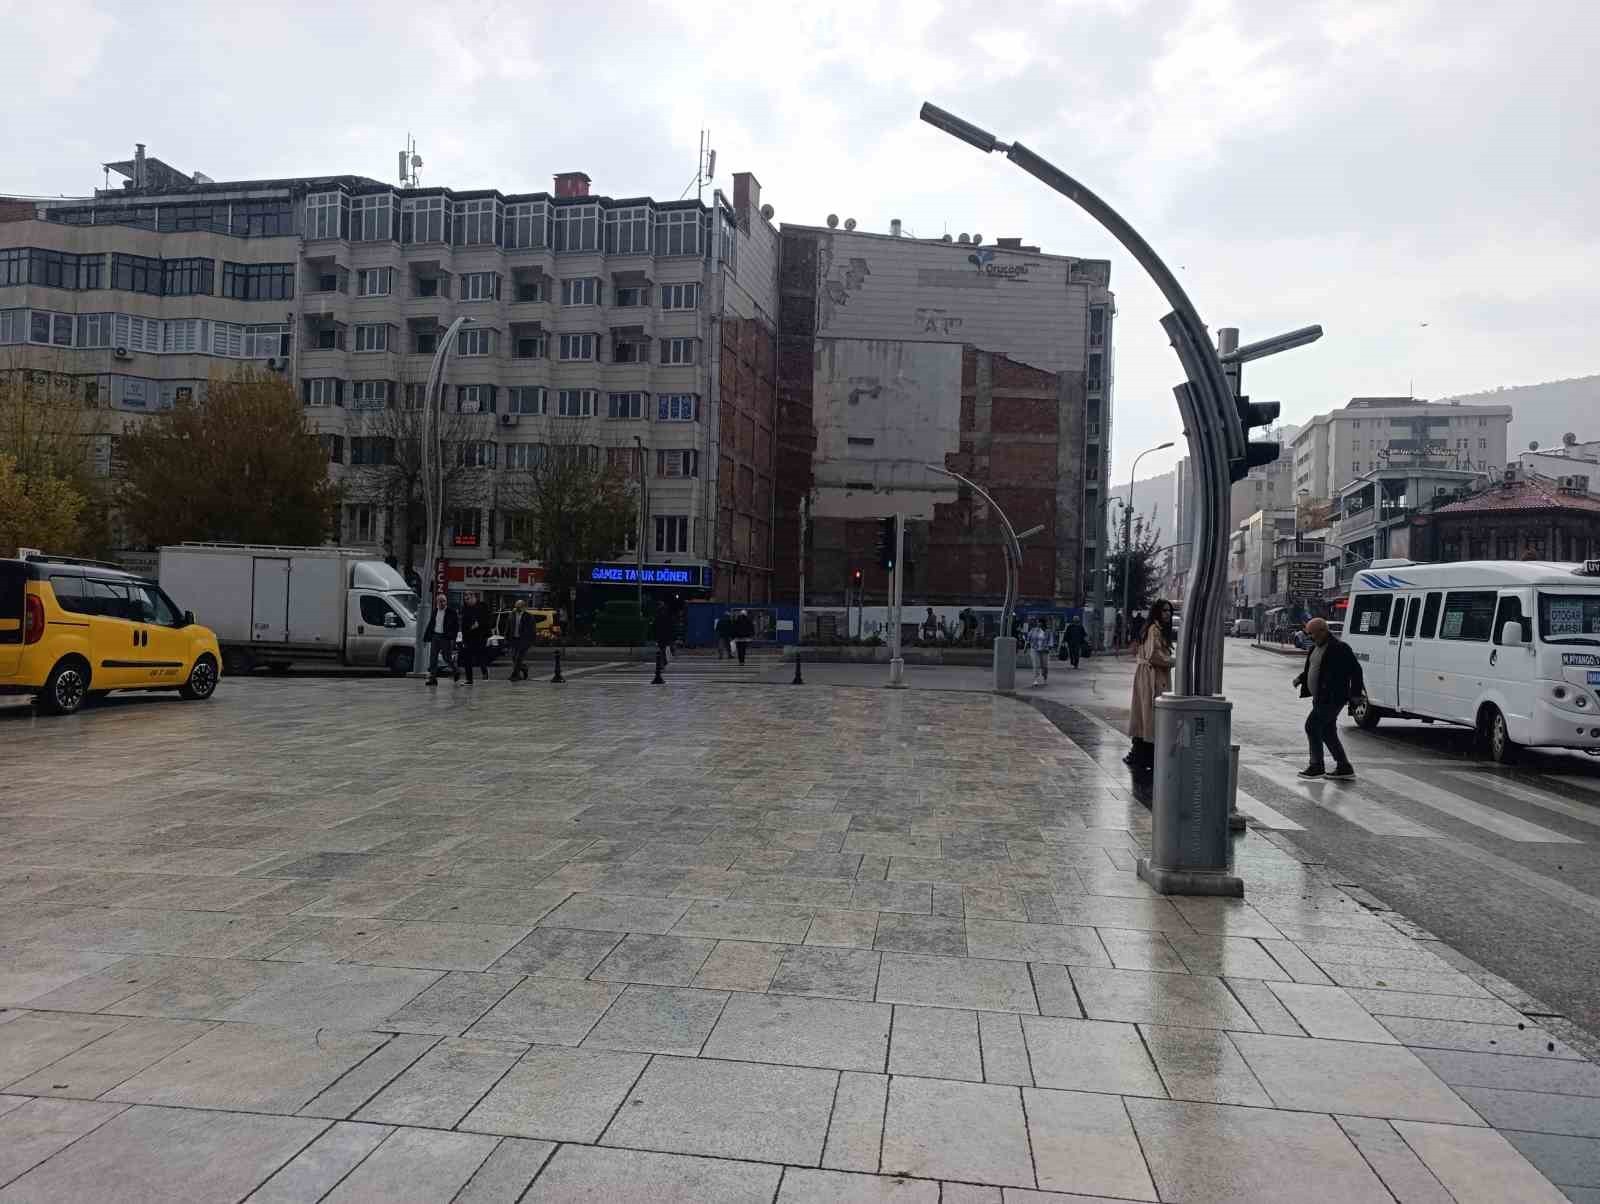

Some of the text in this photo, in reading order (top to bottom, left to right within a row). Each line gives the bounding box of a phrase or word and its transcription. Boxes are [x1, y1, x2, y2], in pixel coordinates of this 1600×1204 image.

[465, 566, 518, 579] ECZANE
[592, 567, 623, 580] GAMZE
[656, 567, 689, 582] DÖNER
